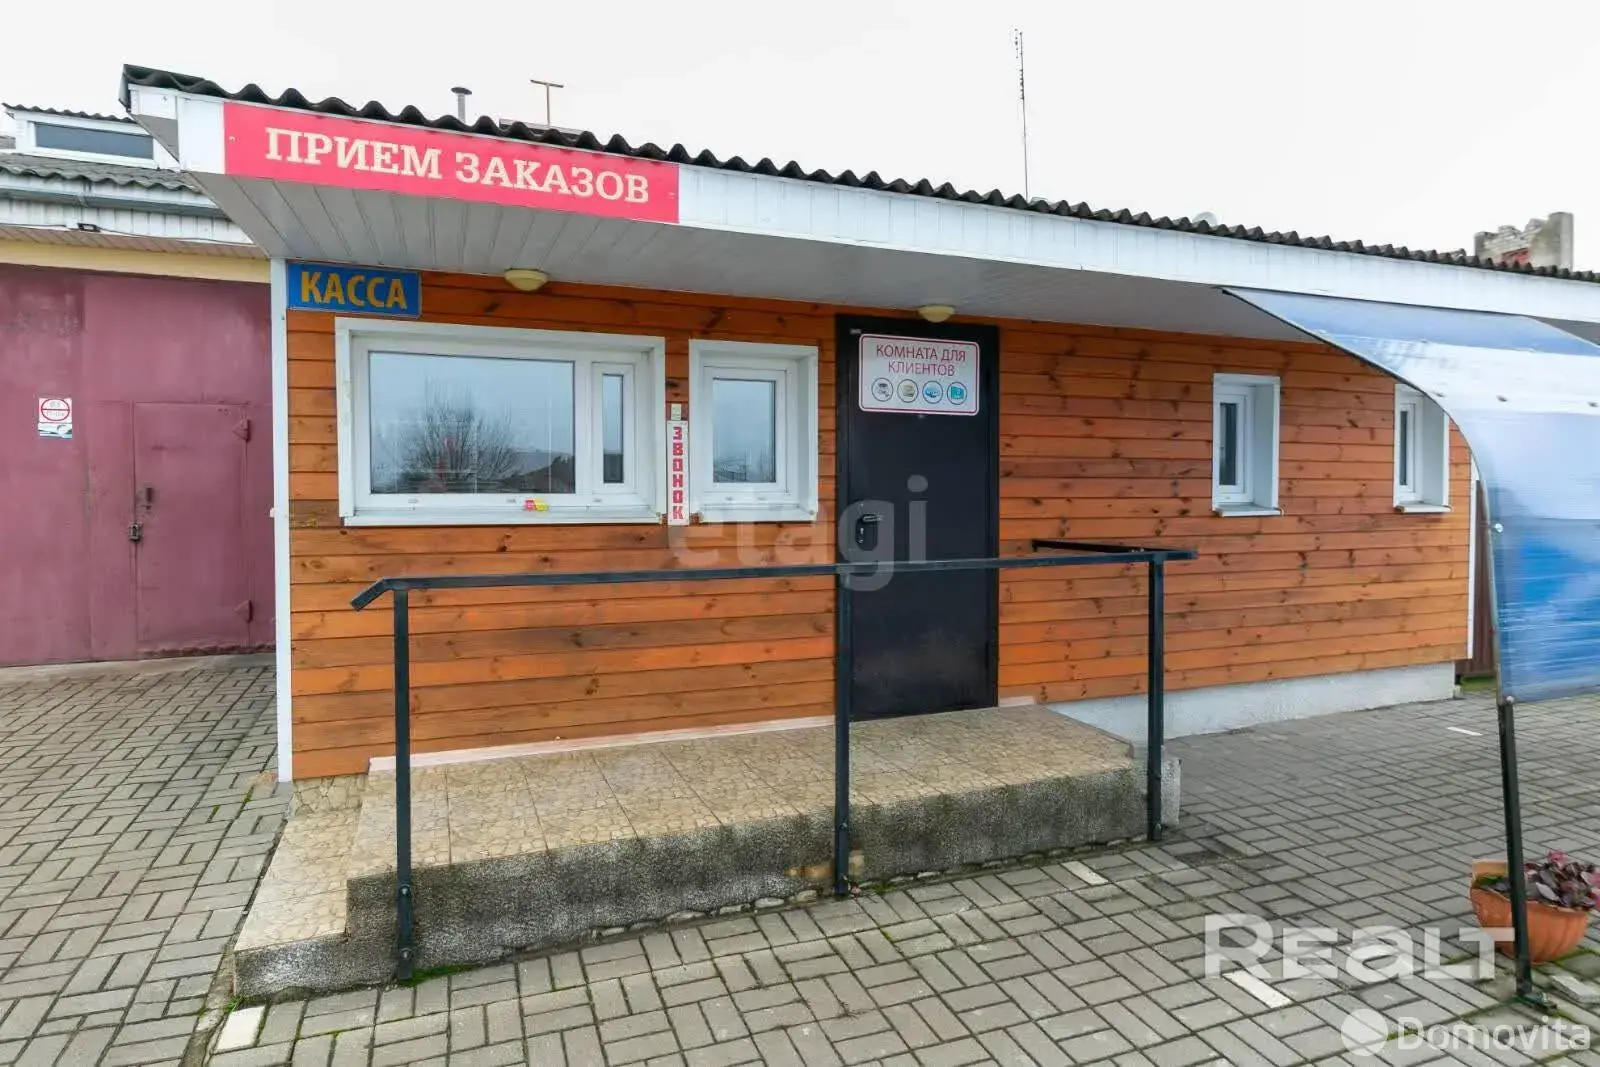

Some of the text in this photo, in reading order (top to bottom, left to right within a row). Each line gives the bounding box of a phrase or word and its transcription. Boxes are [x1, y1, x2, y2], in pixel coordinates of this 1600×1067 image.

[265, 127, 650, 203] ПРИЕМ ЗАКАЗОВ
[301, 271, 408, 310] КАССА
[876, 344, 966, 362] КОМНАТА ДЛЯ
[888, 361, 955, 376] КЛИЕНТОВ
[672, 426, 684, 520] ЗВОНОК
